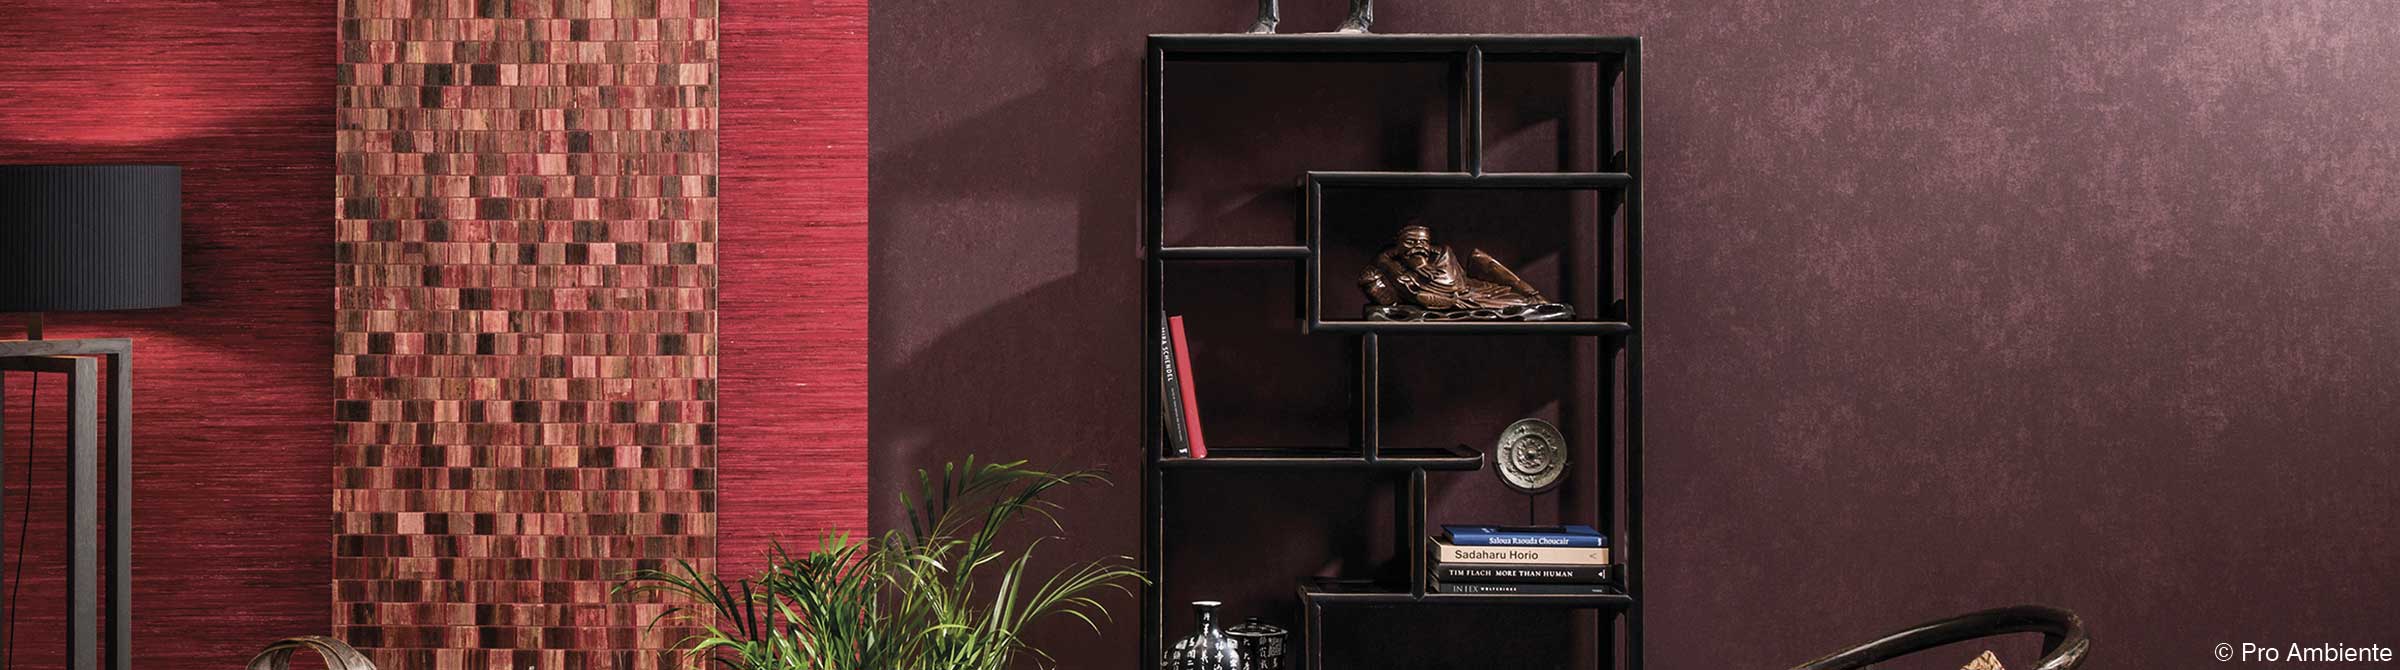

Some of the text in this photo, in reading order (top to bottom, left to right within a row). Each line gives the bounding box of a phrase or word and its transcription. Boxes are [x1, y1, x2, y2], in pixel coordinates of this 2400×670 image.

[1162, 347, 1174, 381] SCHENDEL
[1489, 537, 1569, 545] Saloua Raouda Choucair
[1455, 550, 1539, 560] Sadaharu Horio
[1466, 569, 1492, 577] FLACH
